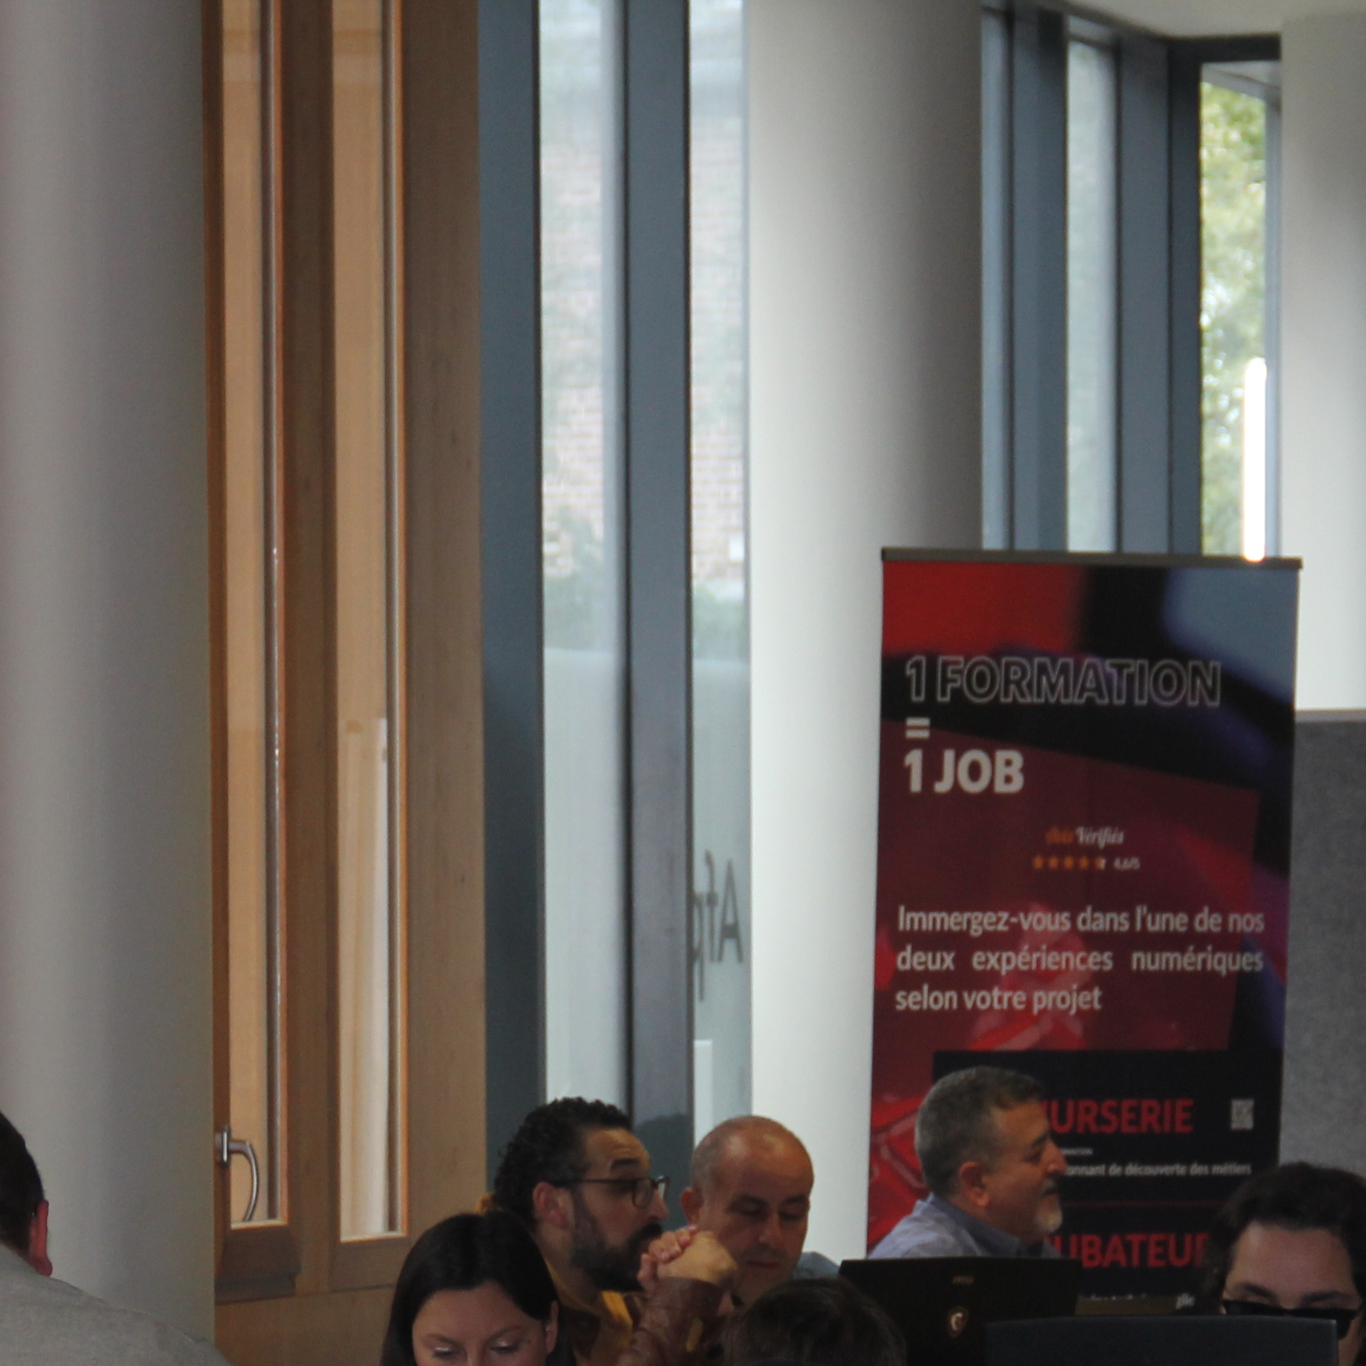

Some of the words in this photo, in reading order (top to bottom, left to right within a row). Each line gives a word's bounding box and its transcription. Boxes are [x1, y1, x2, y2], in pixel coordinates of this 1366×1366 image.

[906, 656, 927, 702] 1
[937, 656, 1222, 706] FORMATION
[903, 749, 923, 793] 1
[933, 749, 1025, 794] JOB
[897, 906, 1071, 935] Immergez-vous
[1076, 906, 1130, 932] dans
[1135, 906, 1188, 933] l'une
[1194, 907, 1222, 933] de
[1227, 913, 1265, 933] nos
[896, 945, 955, 971] deux
[972, 945, 1114, 976] expériences
[1131, 946, 1264, 976] numériques
[895, 985, 958, 1011] selon
[962, 988, 1027, 1011] votre
[1032, 986, 1103, 1015] projet
[1067, 1164, 1106, 1177] onnant
[1108, 1161, 1123, 1177] de
[1125, 1161, 1187, 1177] découverte
[1189, 1161, 1210, 1177] des
[1212, 1160, 1253, 1176] métiers
[1045, 1232, 1210, 1269] UBATEU
